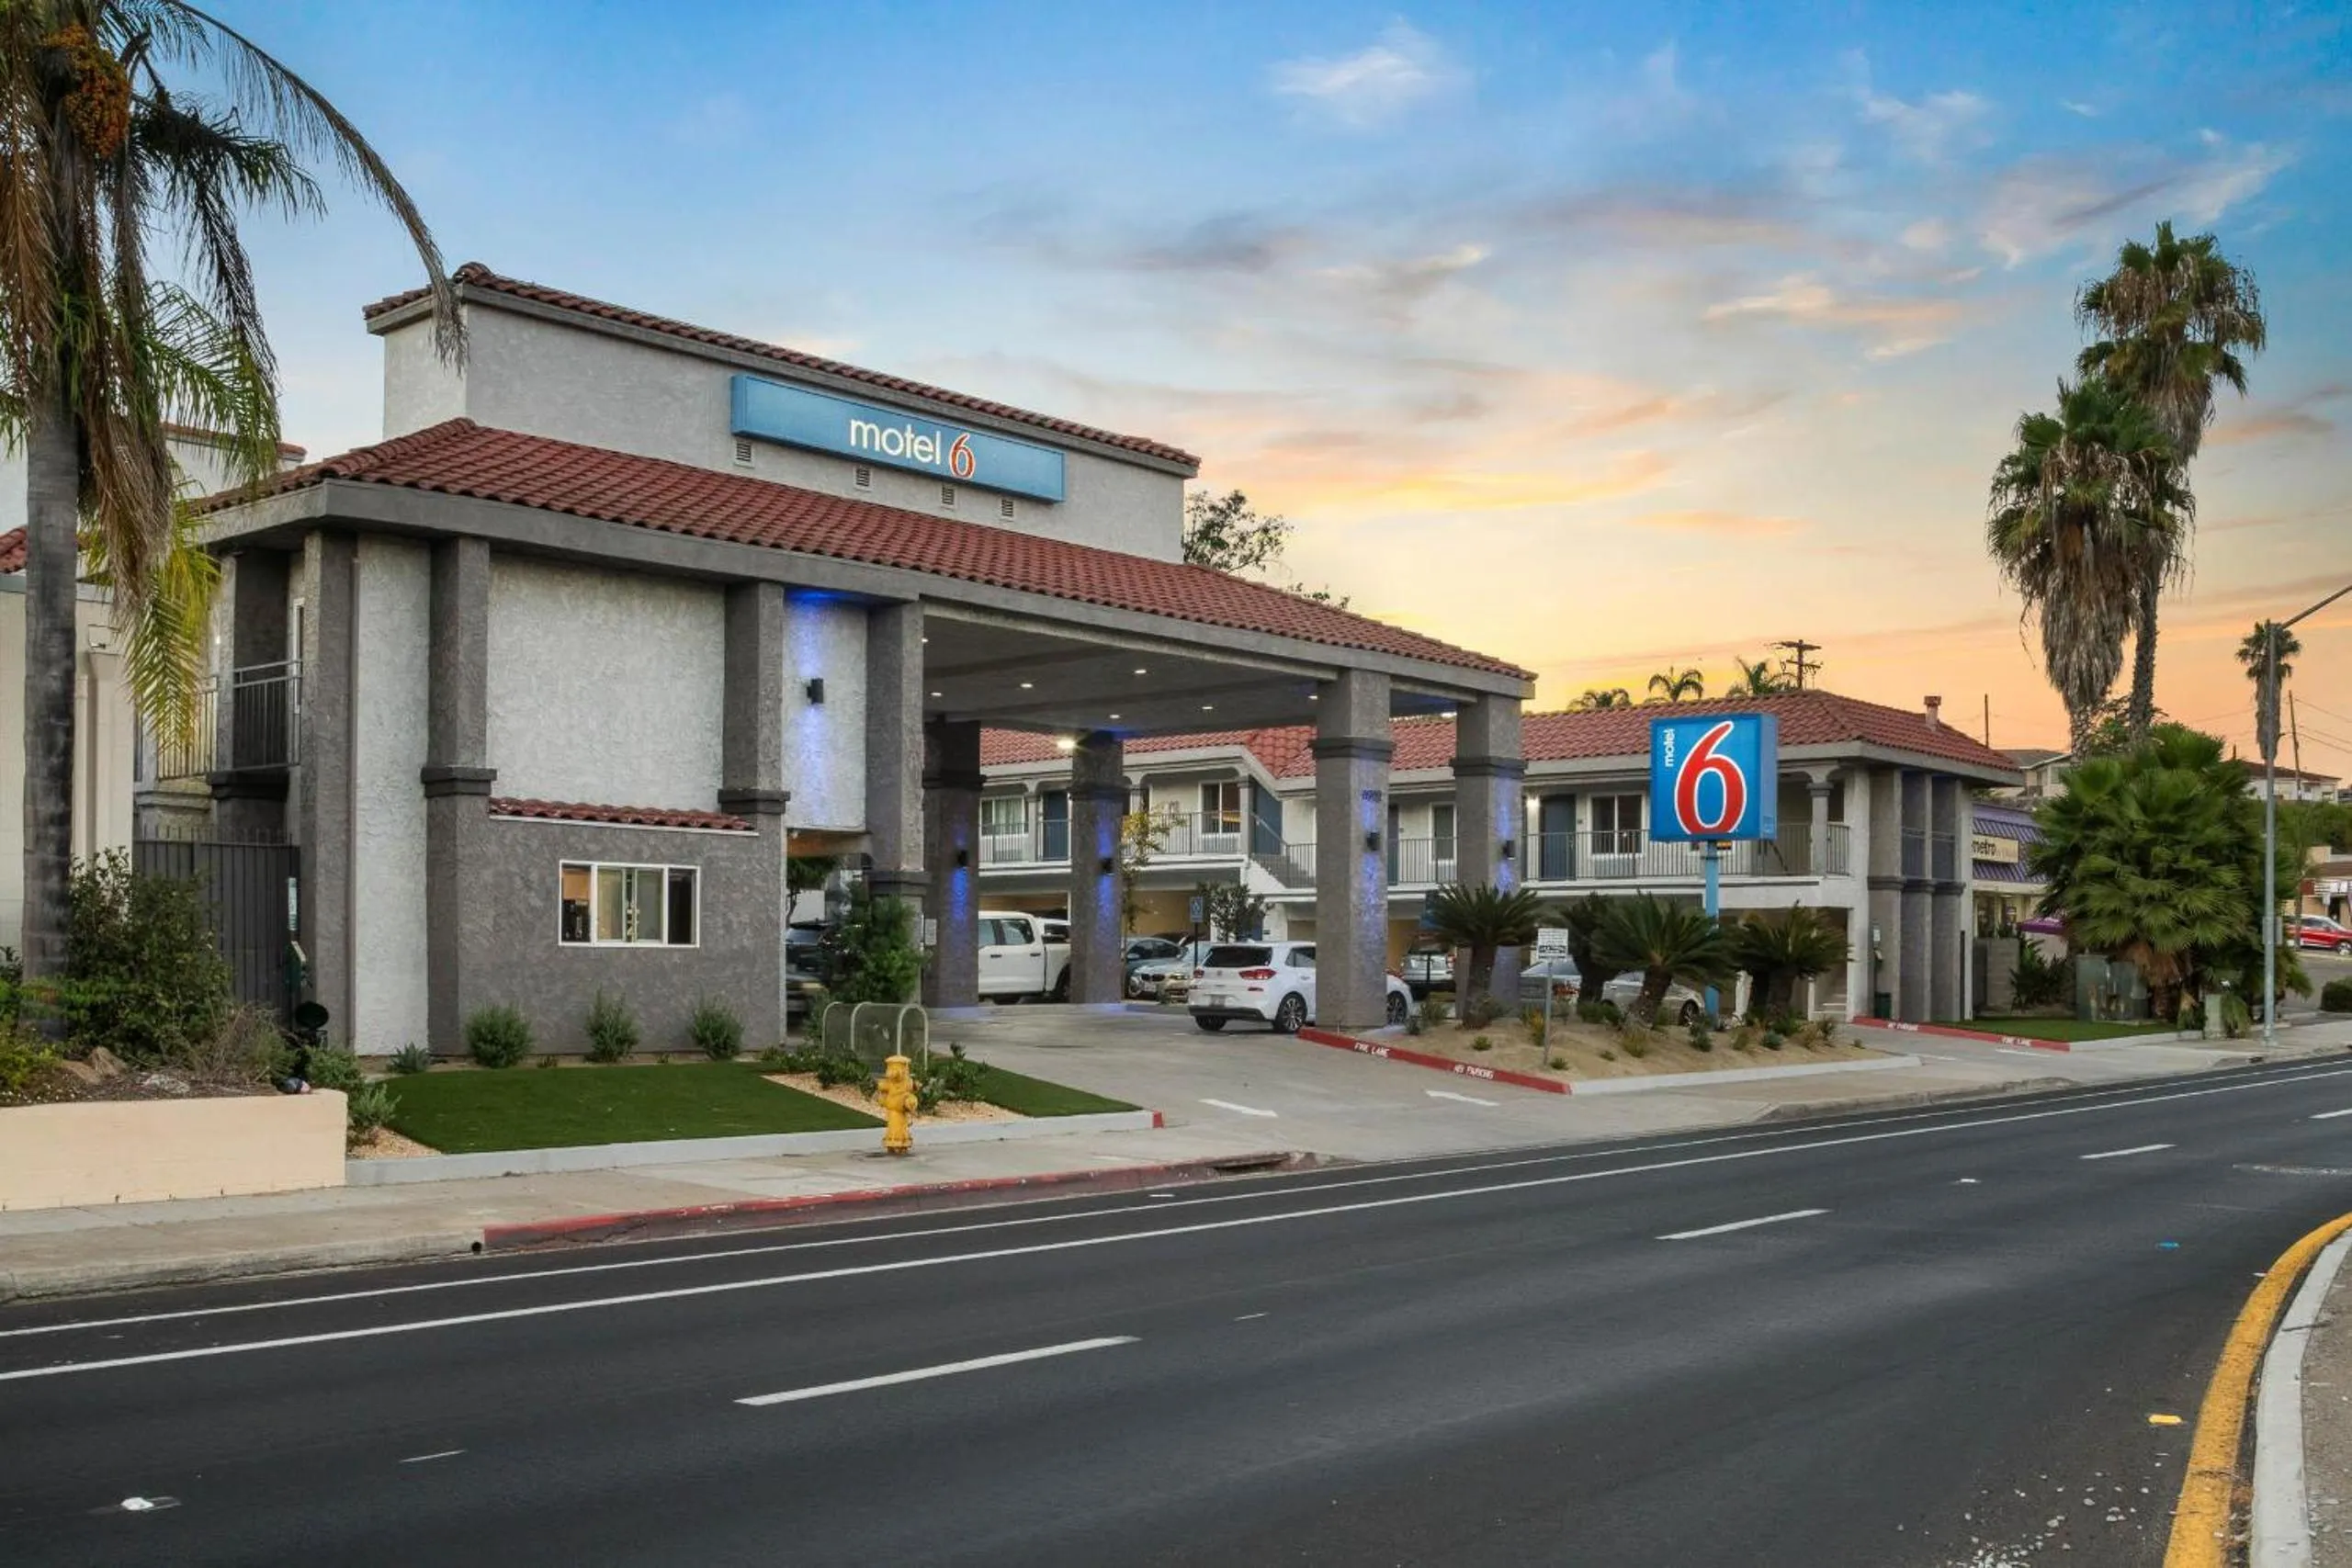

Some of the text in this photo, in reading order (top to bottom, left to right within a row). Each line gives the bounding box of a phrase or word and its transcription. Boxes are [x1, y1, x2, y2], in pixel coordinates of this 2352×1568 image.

[850, 419, 977, 479] motel 6
[1663, 728, 1676, 768] motel
[1674, 721, 1747, 834] 6
